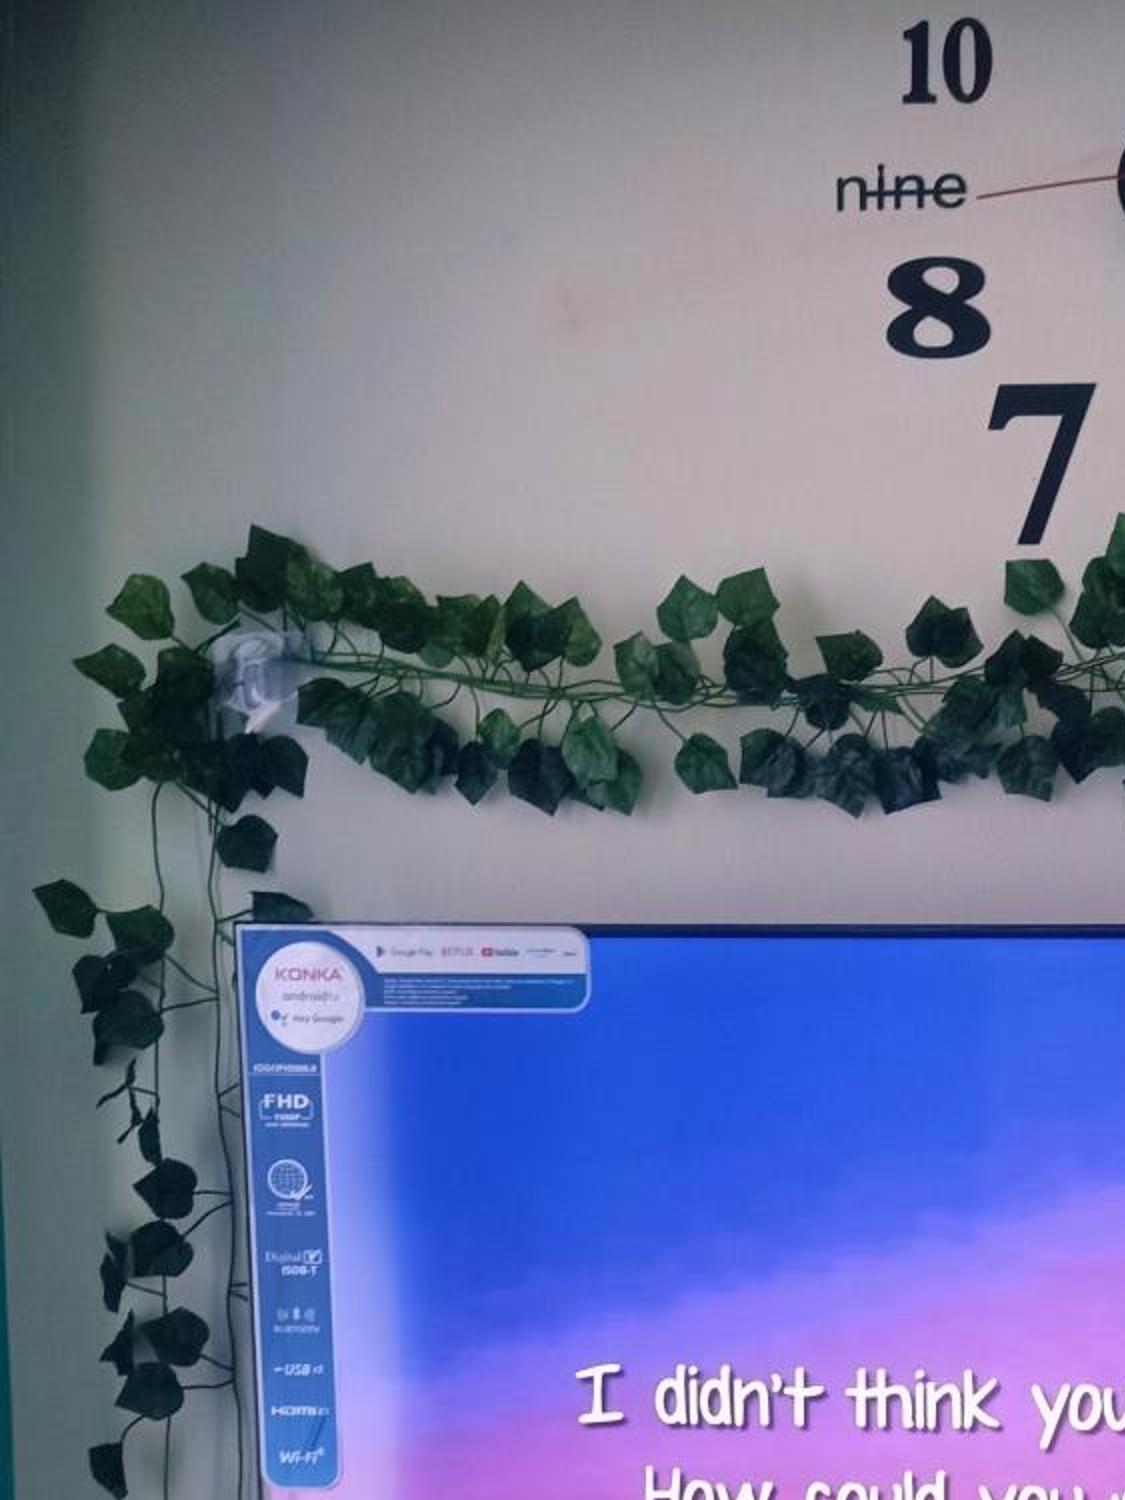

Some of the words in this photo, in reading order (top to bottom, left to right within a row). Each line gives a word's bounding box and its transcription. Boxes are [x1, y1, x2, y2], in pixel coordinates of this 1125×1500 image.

[903, 17, 994, 106] 10
[836, 164, 967, 212] nine
[886, 256, 992, 360] 8
[987, 383, 1097, 545] 7
[274, 967, 343, 982] KONKA
[263, 1093, 310, 1110] FHD
[576, 1364, 624, 1424] I
[655, 1364, 825, 1427] didn't
[846, 1367, 1001, 1430] think
